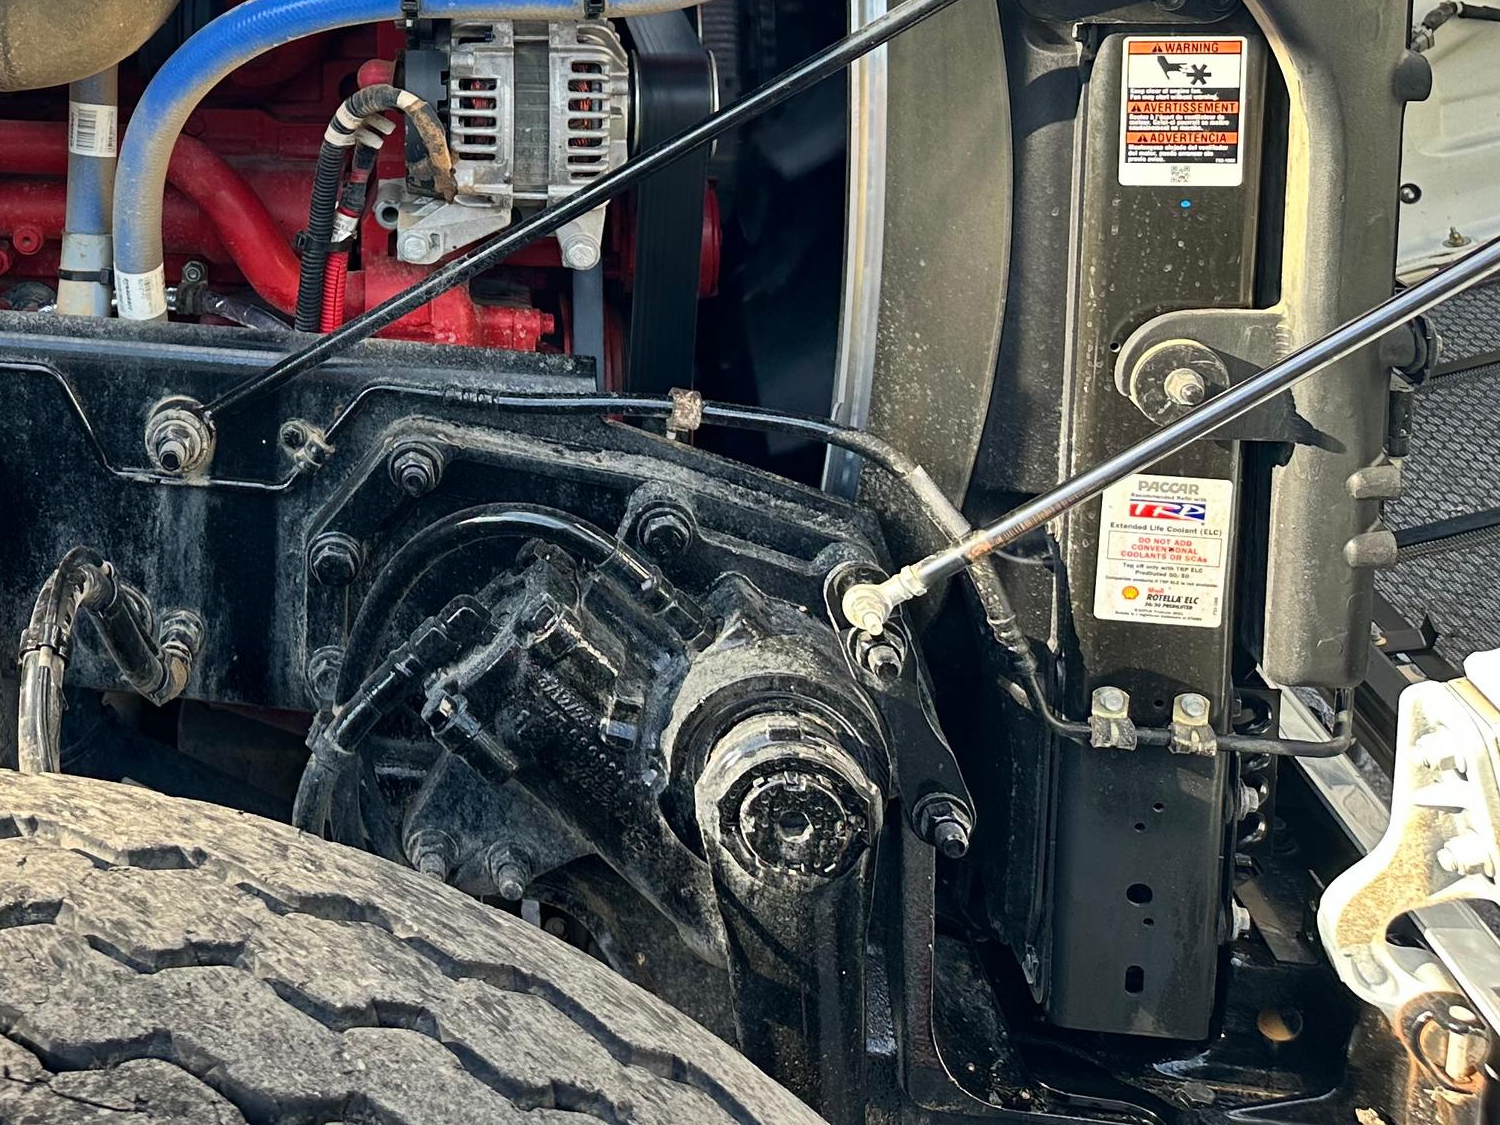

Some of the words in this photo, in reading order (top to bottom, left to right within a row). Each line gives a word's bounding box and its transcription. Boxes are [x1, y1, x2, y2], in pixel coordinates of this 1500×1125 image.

[1165, 43, 1219, 52] WARNING
[1144, 103, 1235, 112] AVERTISSEMENT
[1150, 133, 1227, 142] ADVERTENCIA
[1139, 481, 1199, 495] PACCAR
[1135, 504, 1205, 521] TRP
[1111, 522, 1147, 530] Extended
[1167, 526, 1197, 534] Coolant
[1200, 529, 1222, 537] (ELC)
[1121, 551, 1166, 560] COOLANTS
[1185, 596, 1199, 604] ELC
